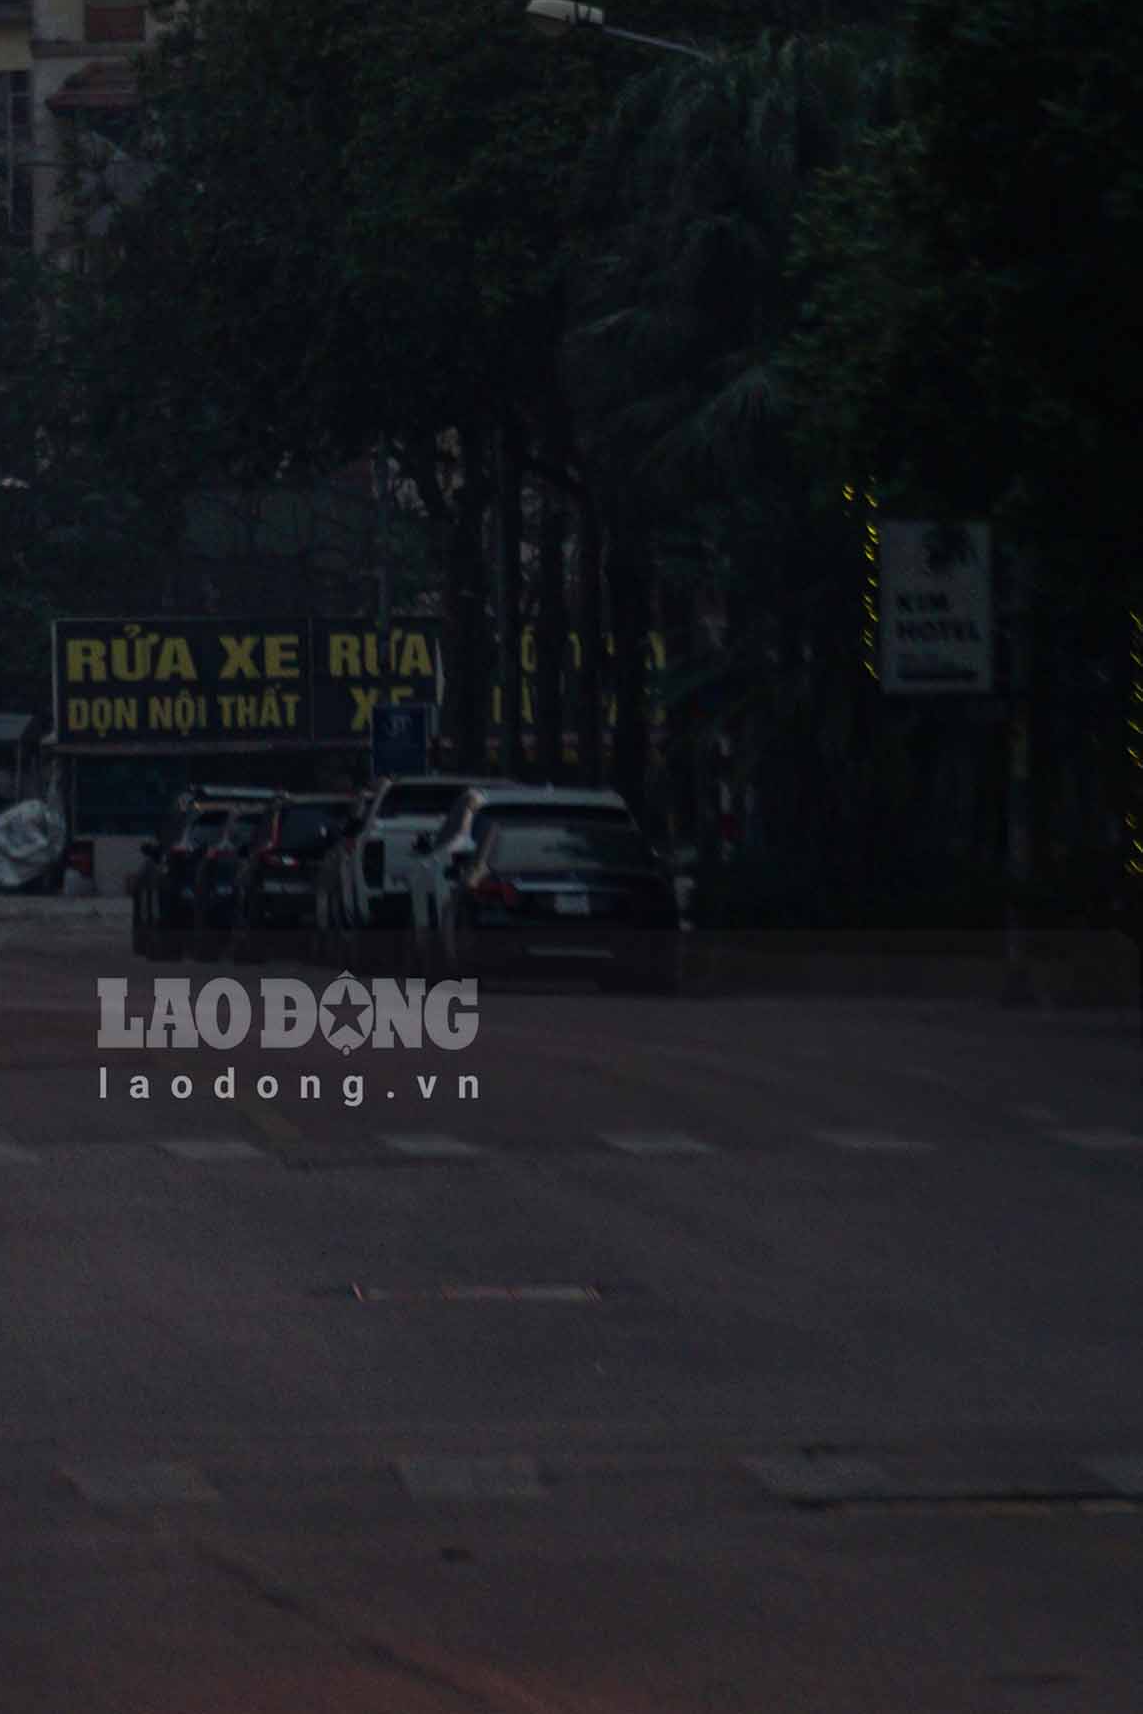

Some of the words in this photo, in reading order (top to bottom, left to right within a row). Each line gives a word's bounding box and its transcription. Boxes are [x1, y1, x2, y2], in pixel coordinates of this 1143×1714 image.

[64, 624, 199, 683] RỬA
[217, 633, 300, 679] XE
[67, 696, 138, 737] DỌN
[146, 690, 209, 736] NỘI
[216, 684, 301, 730] THẤT
